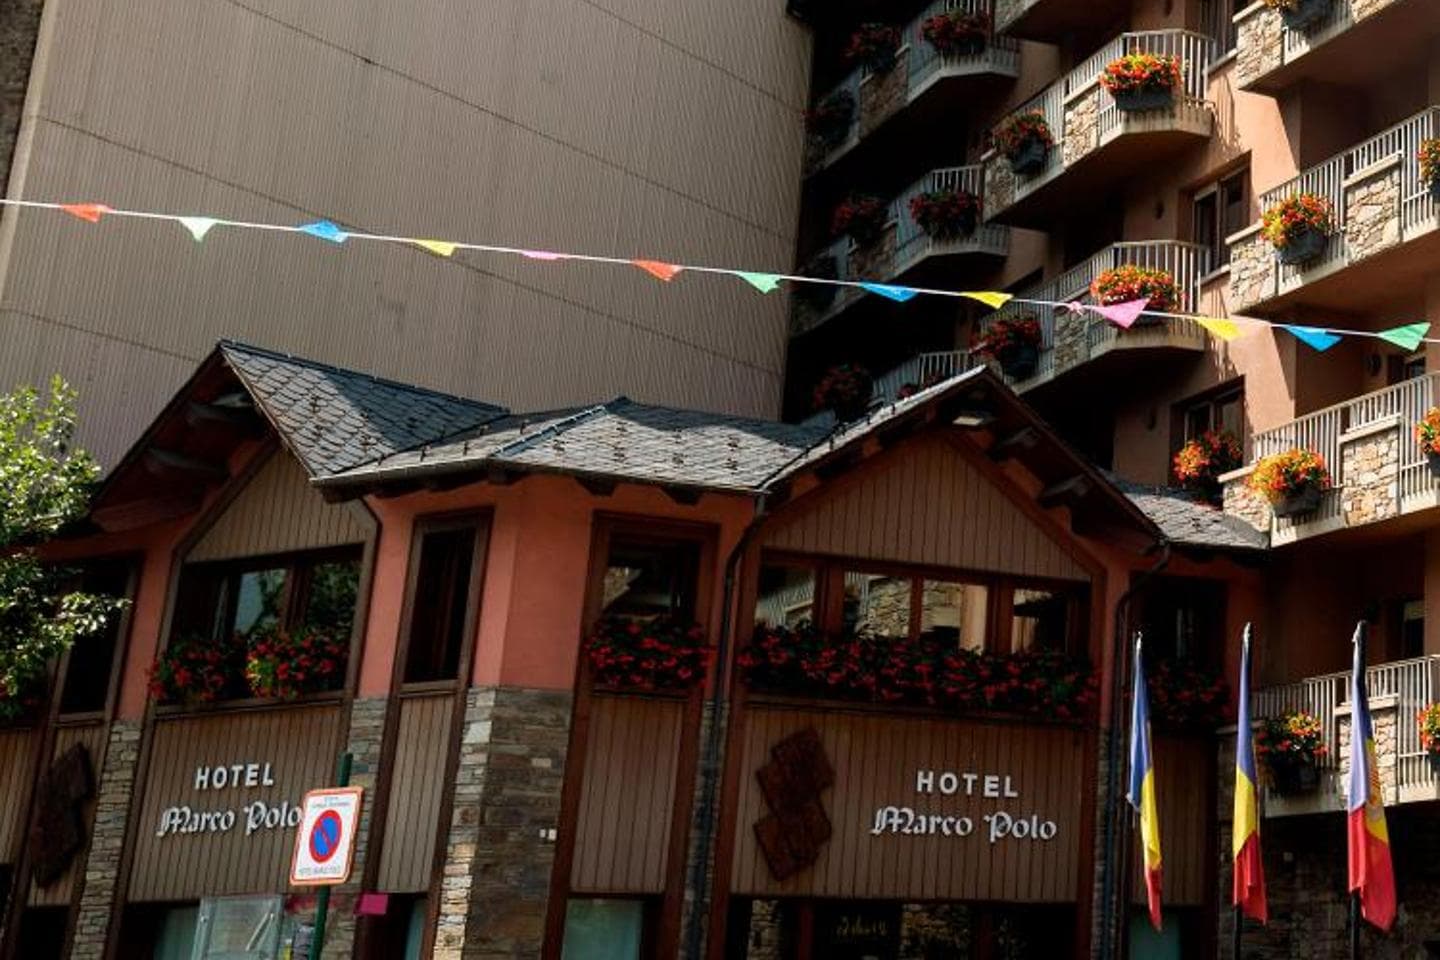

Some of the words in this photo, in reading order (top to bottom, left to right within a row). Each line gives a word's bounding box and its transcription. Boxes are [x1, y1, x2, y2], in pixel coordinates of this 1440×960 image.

[194, 762, 275, 790] HOTEL
[916, 770, 1019, 798] HOTEL
[155, 805, 236, 838] Marco
[243, 800, 302, 836] Polo
[869, 805, 974, 837] Marco
[982, 810, 1058, 843] Polo
